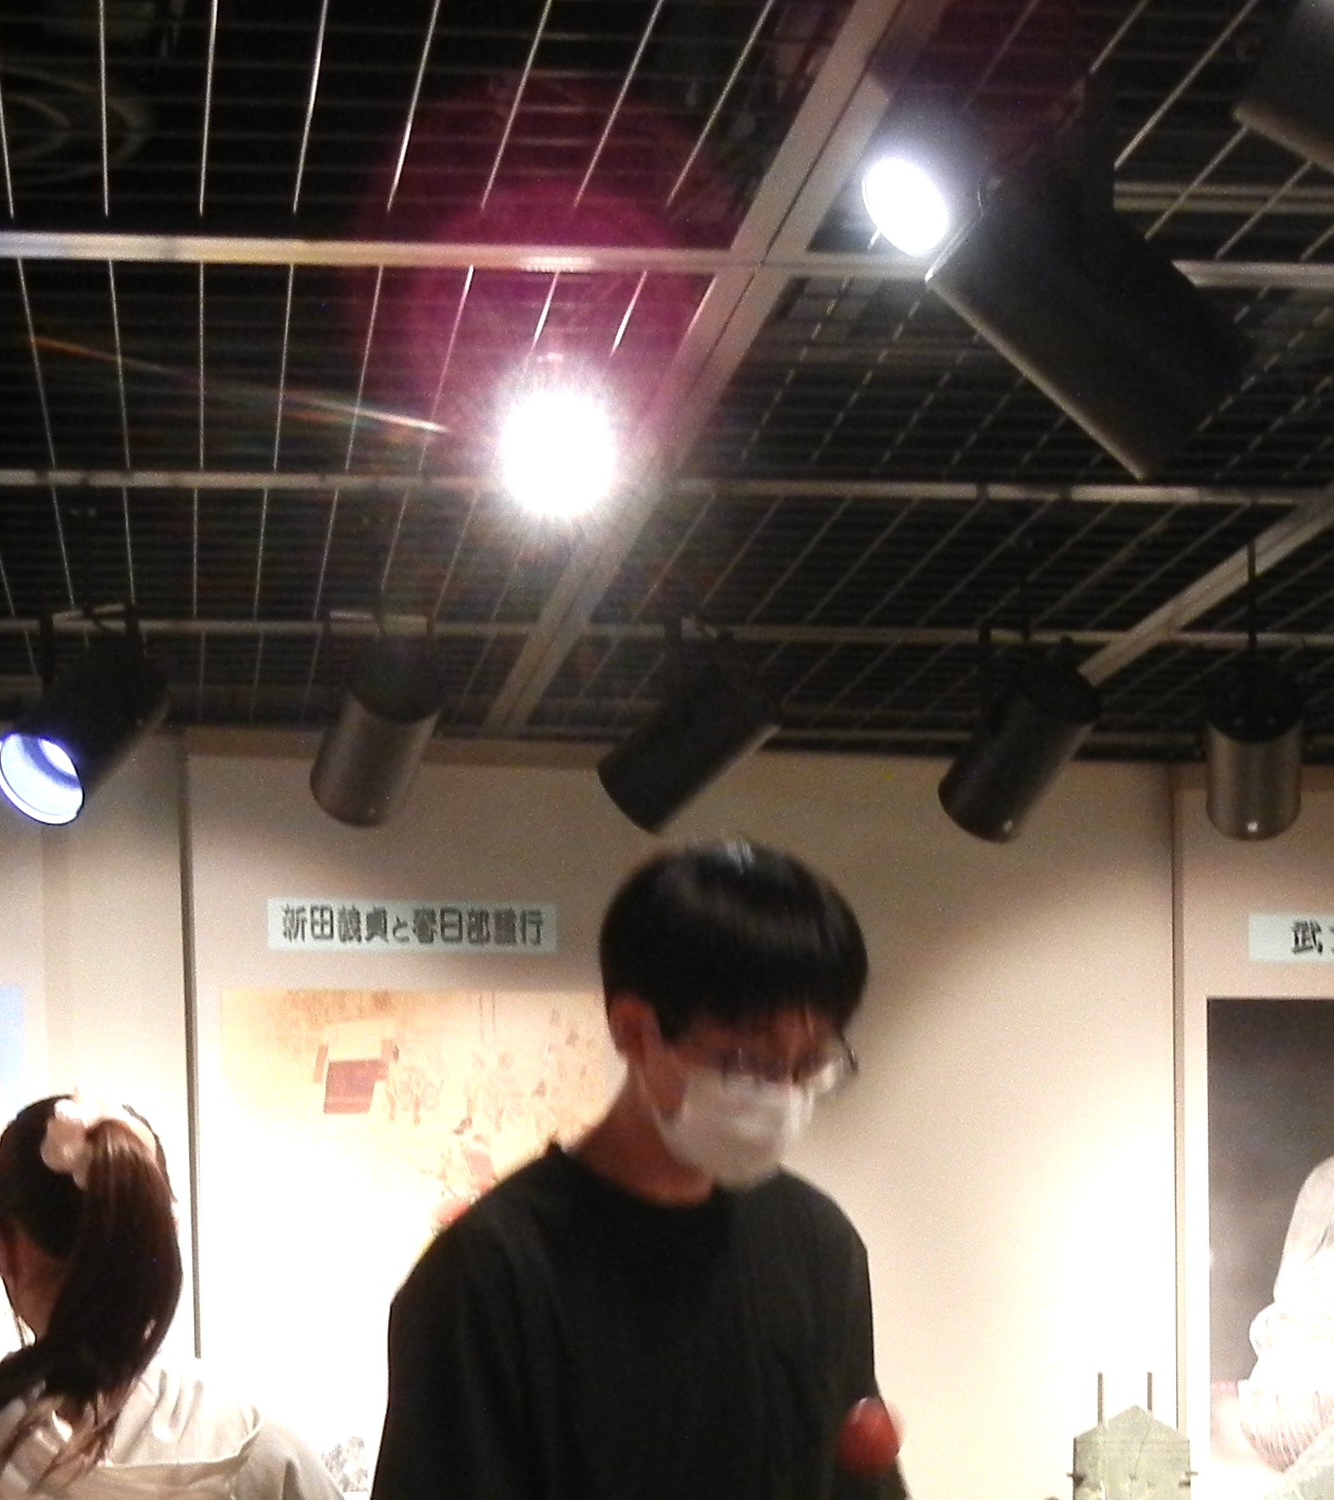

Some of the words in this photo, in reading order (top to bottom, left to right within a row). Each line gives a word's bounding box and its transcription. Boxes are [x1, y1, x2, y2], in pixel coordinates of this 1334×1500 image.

[282, 903, 545, 946] 新田義貞と春日部重行
